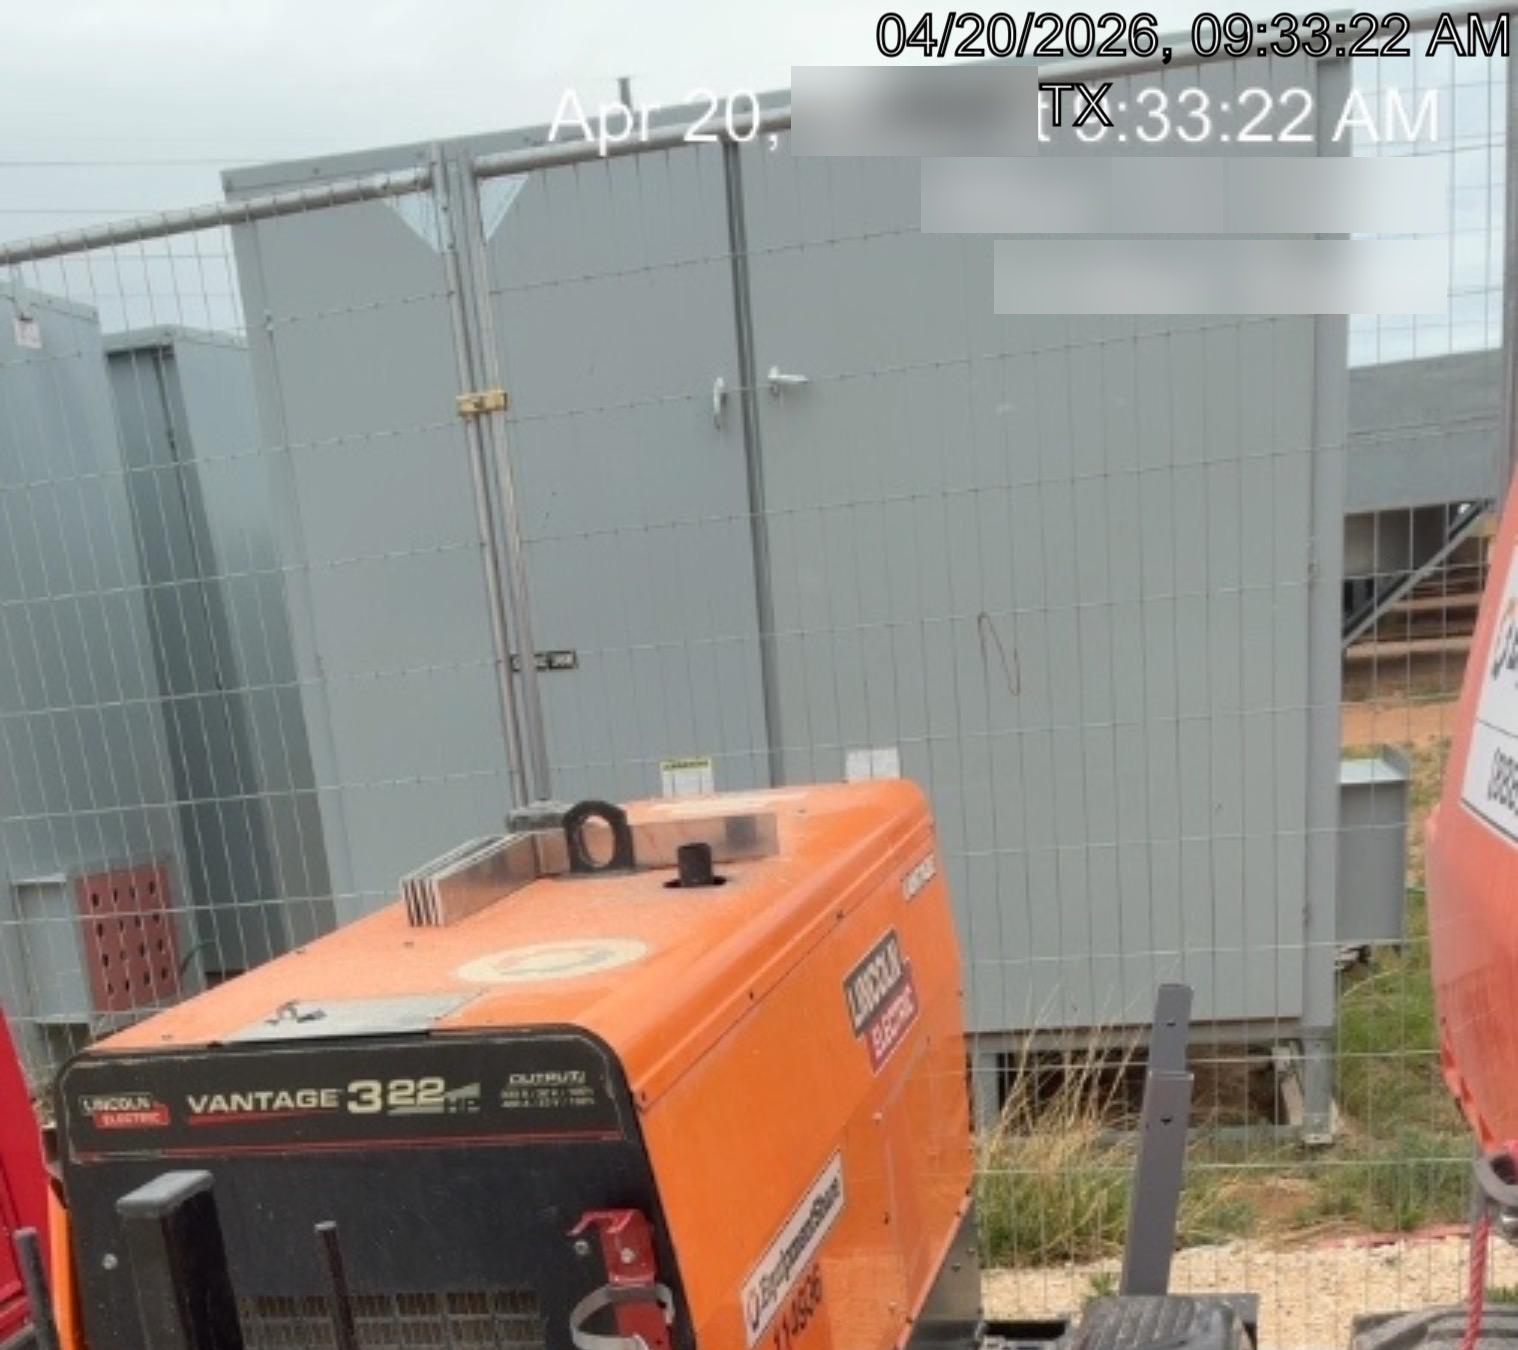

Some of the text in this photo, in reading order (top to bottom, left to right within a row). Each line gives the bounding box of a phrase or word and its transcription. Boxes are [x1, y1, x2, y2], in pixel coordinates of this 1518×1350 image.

[848, 938, 903, 1028] LINCOLN
[870, 981, 916, 1061] ELECTRIC
[83, 1096, 151, 1113] LINCOLN
[187, 1076, 446, 1114] VANTAGE 322
[101, 1111, 160, 1126] ELECTRIC
